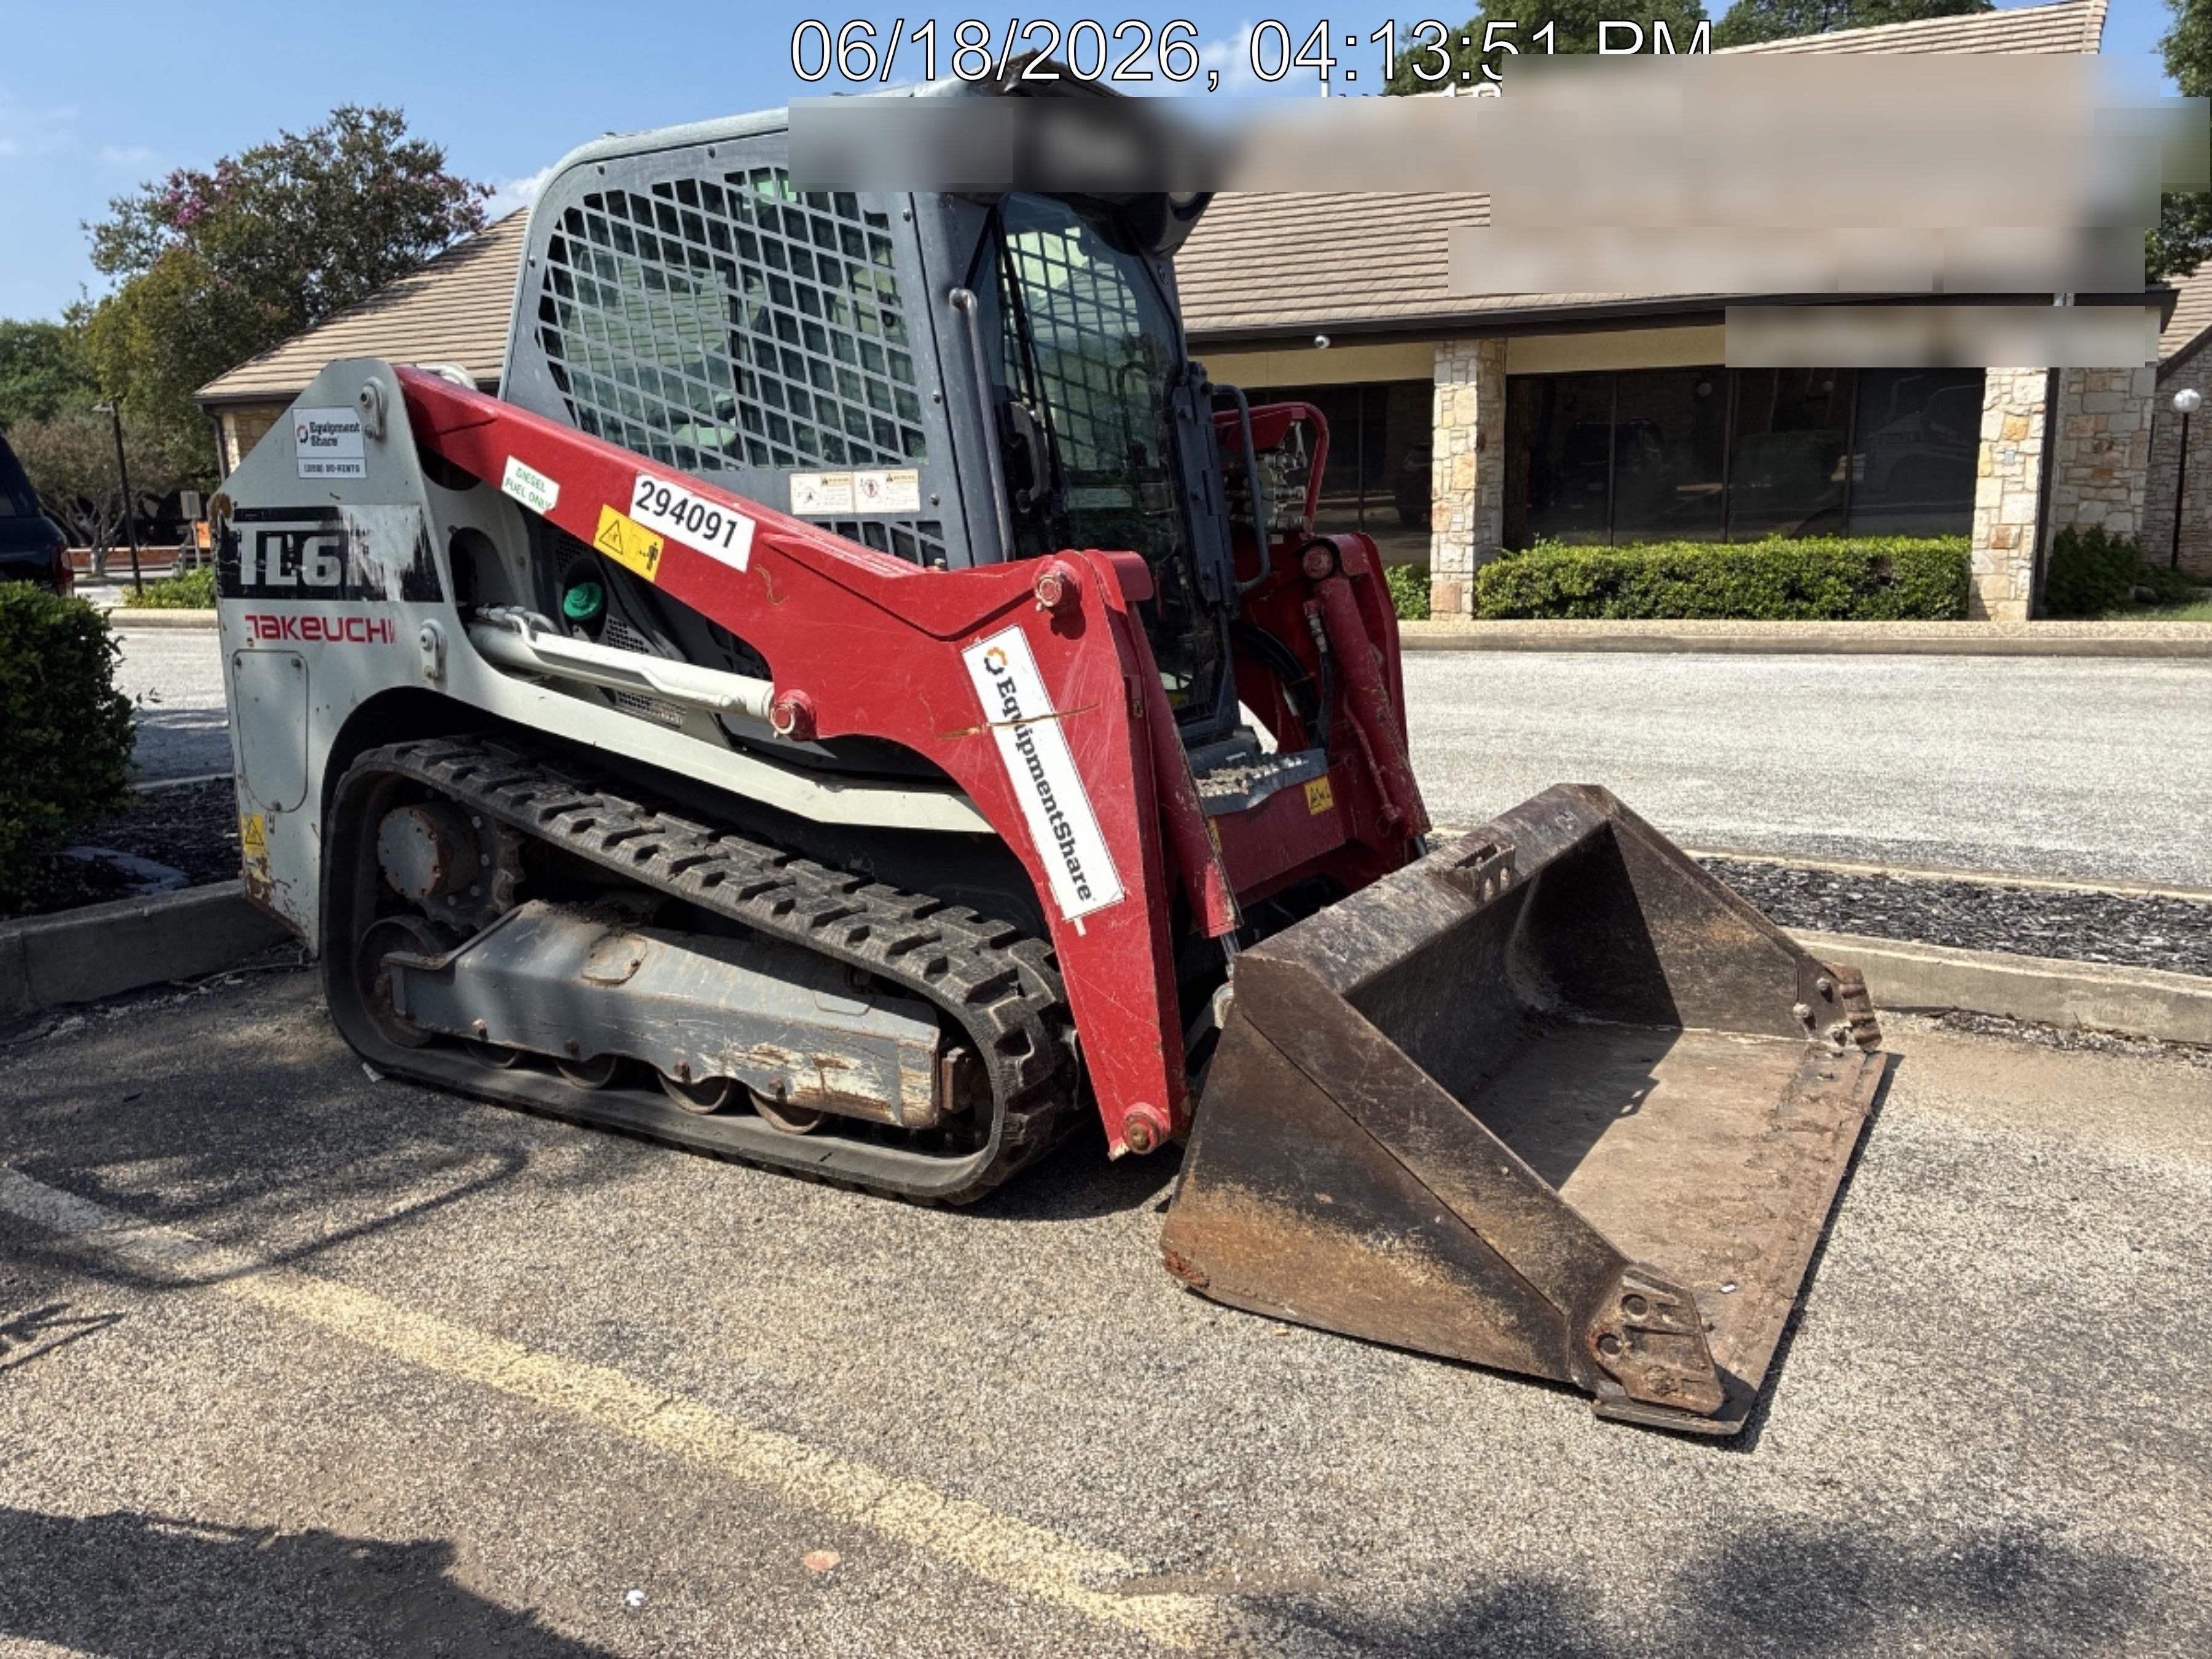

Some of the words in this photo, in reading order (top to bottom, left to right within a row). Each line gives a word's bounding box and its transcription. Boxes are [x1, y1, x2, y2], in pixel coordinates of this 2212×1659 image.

[309, 422, 360, 435] Equipment
[310, 436, 338, 447] Share
[505, 477, 525, 498] FUEL
[529, 492, 552, 509] ONLY
[516, 467, 546, 492] DIESEL
[635, 480, 739, 549] 294091
[996, 677, 1092, 901] EquipmentShare
